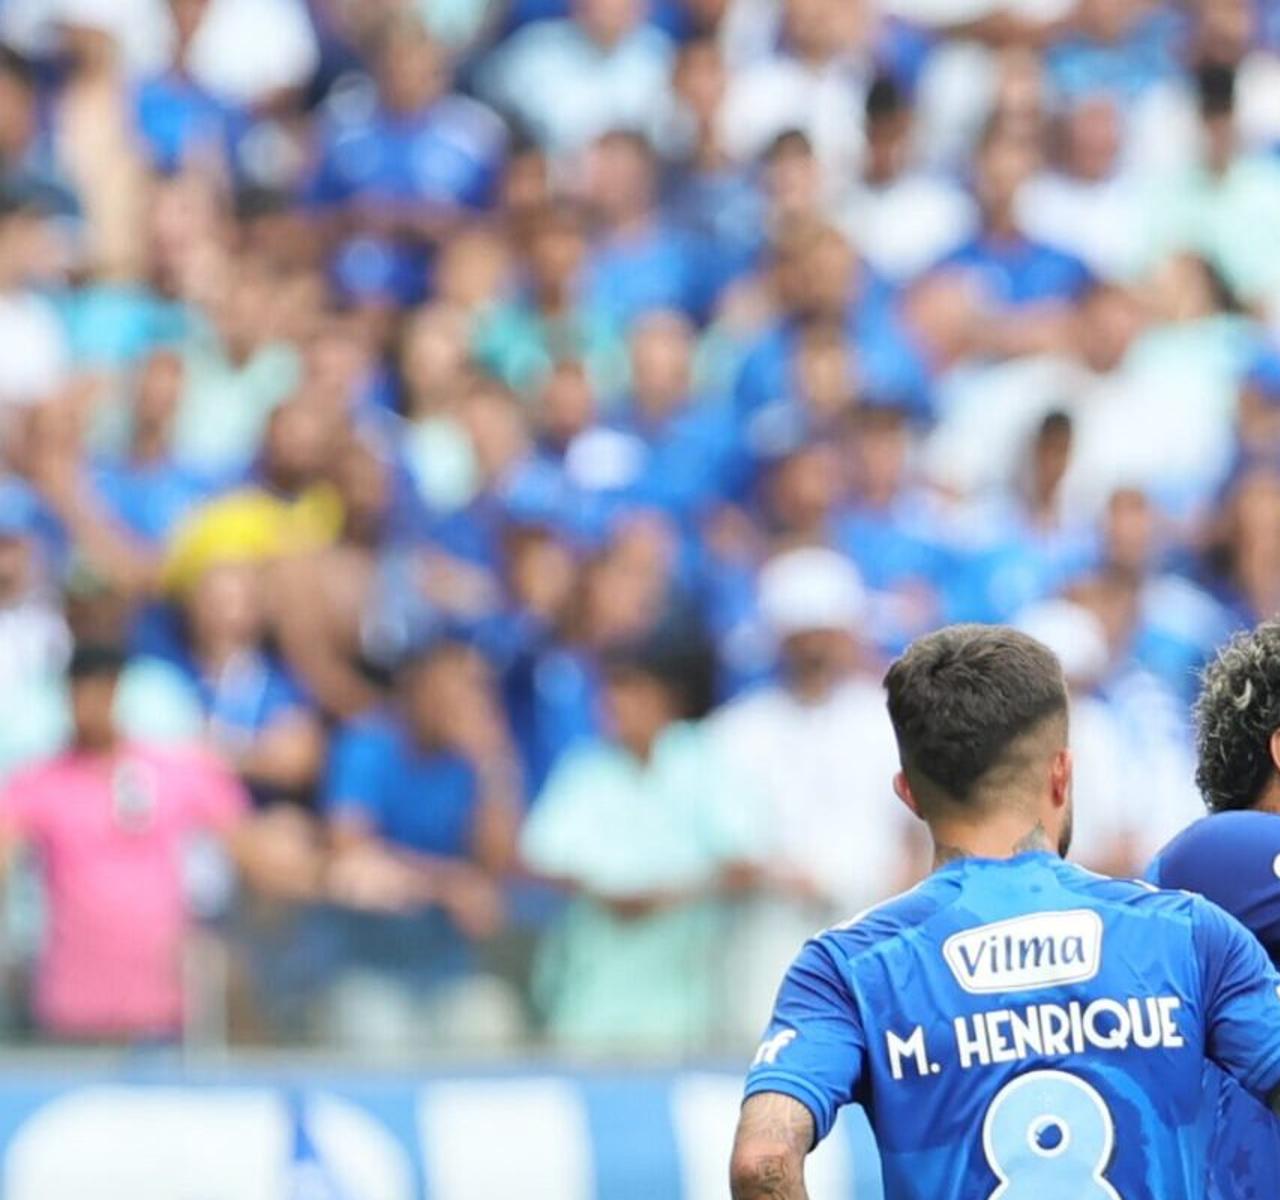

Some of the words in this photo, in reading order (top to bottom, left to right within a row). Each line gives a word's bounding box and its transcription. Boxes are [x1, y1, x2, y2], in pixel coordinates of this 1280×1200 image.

[958, 935, 1086, 978] Vilma
[886, 1030, 941, 1080] M.
[953, 996, 1184, 1068] HENRIQUE
